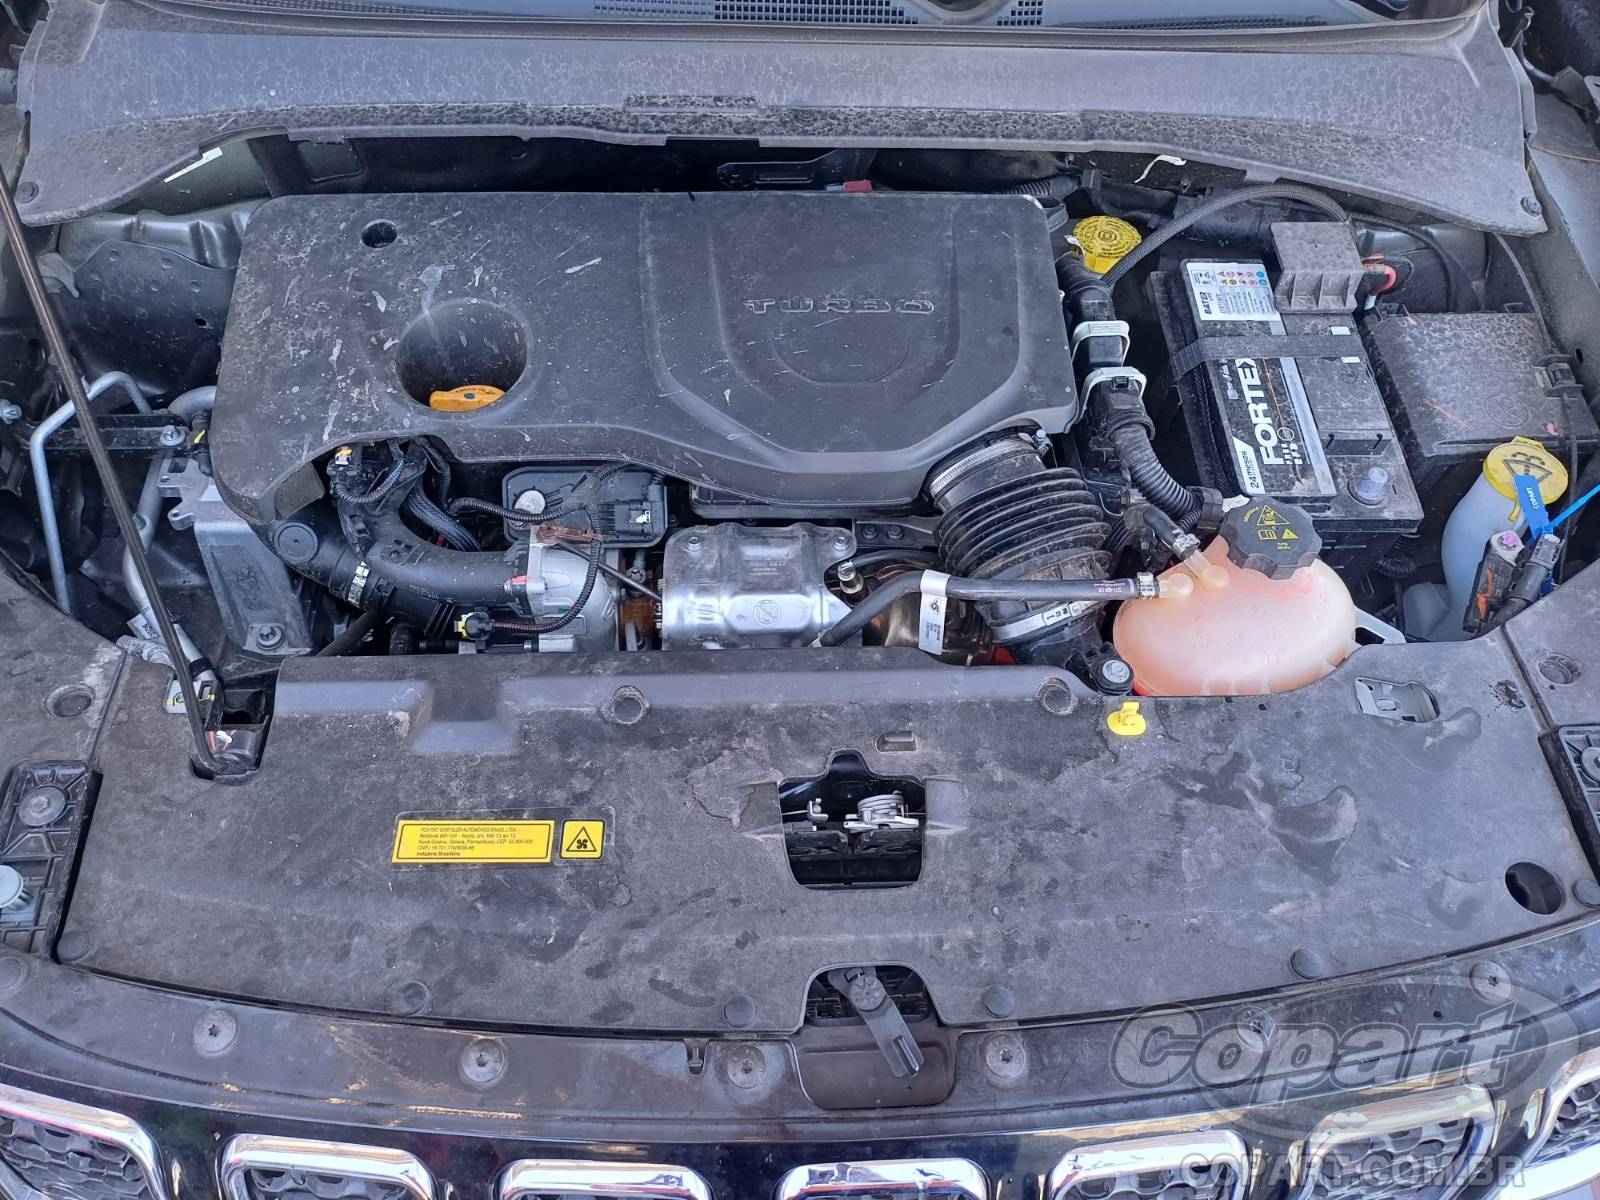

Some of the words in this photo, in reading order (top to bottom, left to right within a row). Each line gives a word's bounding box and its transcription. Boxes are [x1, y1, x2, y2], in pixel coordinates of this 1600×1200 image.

[743, 297, 935, 314] TURBO
[1248, 475, 1260, 489] 24
[1526, 487, 1540, 509] COPART
